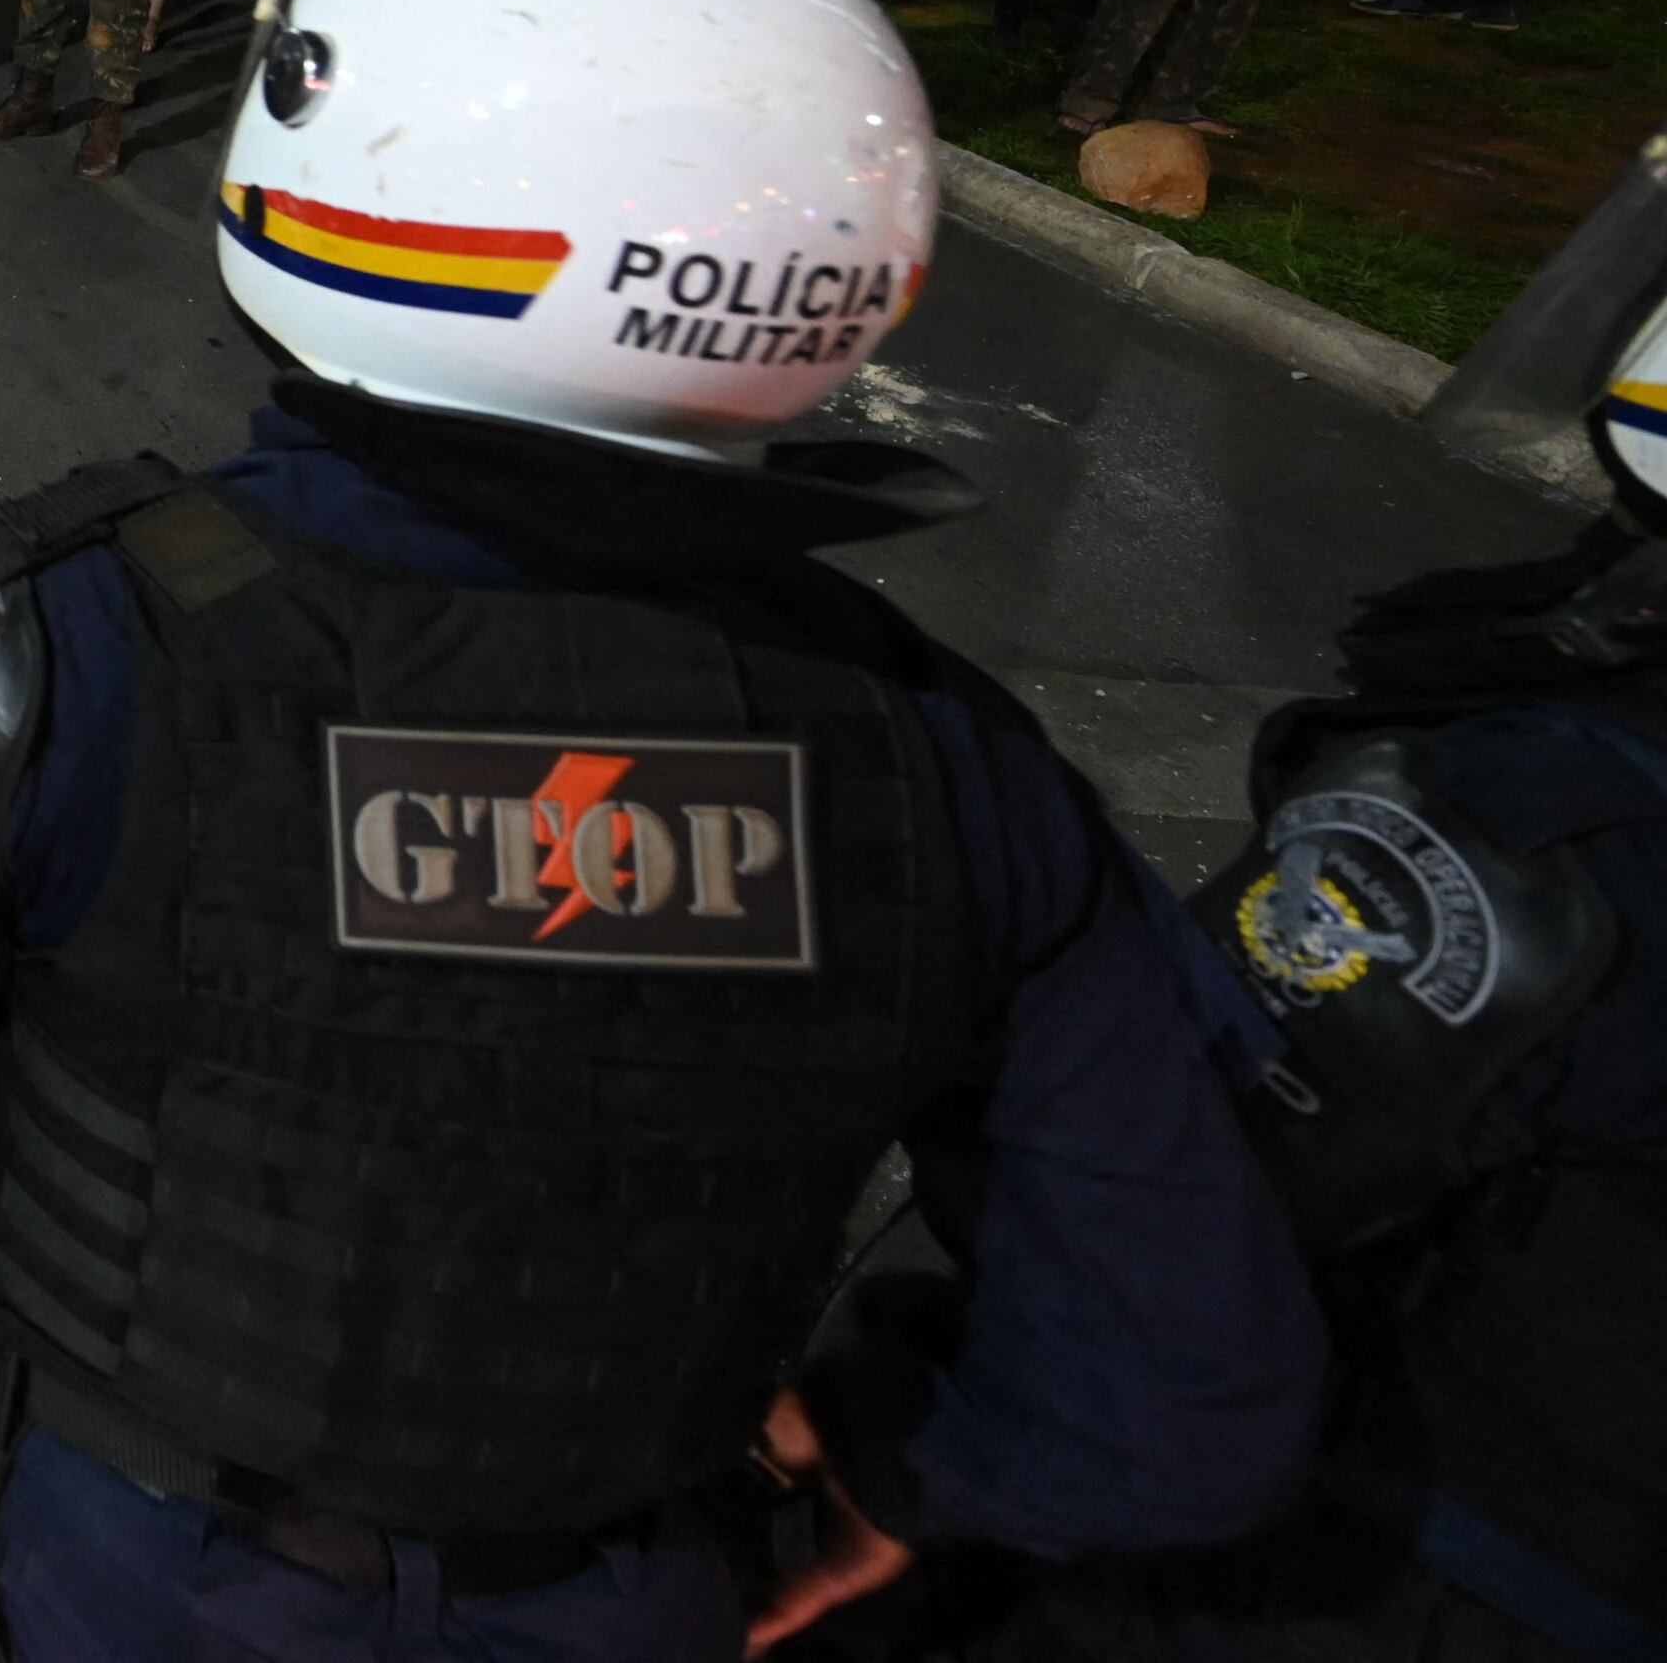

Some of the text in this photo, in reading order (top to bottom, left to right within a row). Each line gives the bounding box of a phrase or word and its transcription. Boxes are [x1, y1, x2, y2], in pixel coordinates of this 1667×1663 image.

[607, 239, 893, 320] POLÍCIA
[614, 306, 865, 367] MILITAR
[353, 789, 783, 920] GTOP
